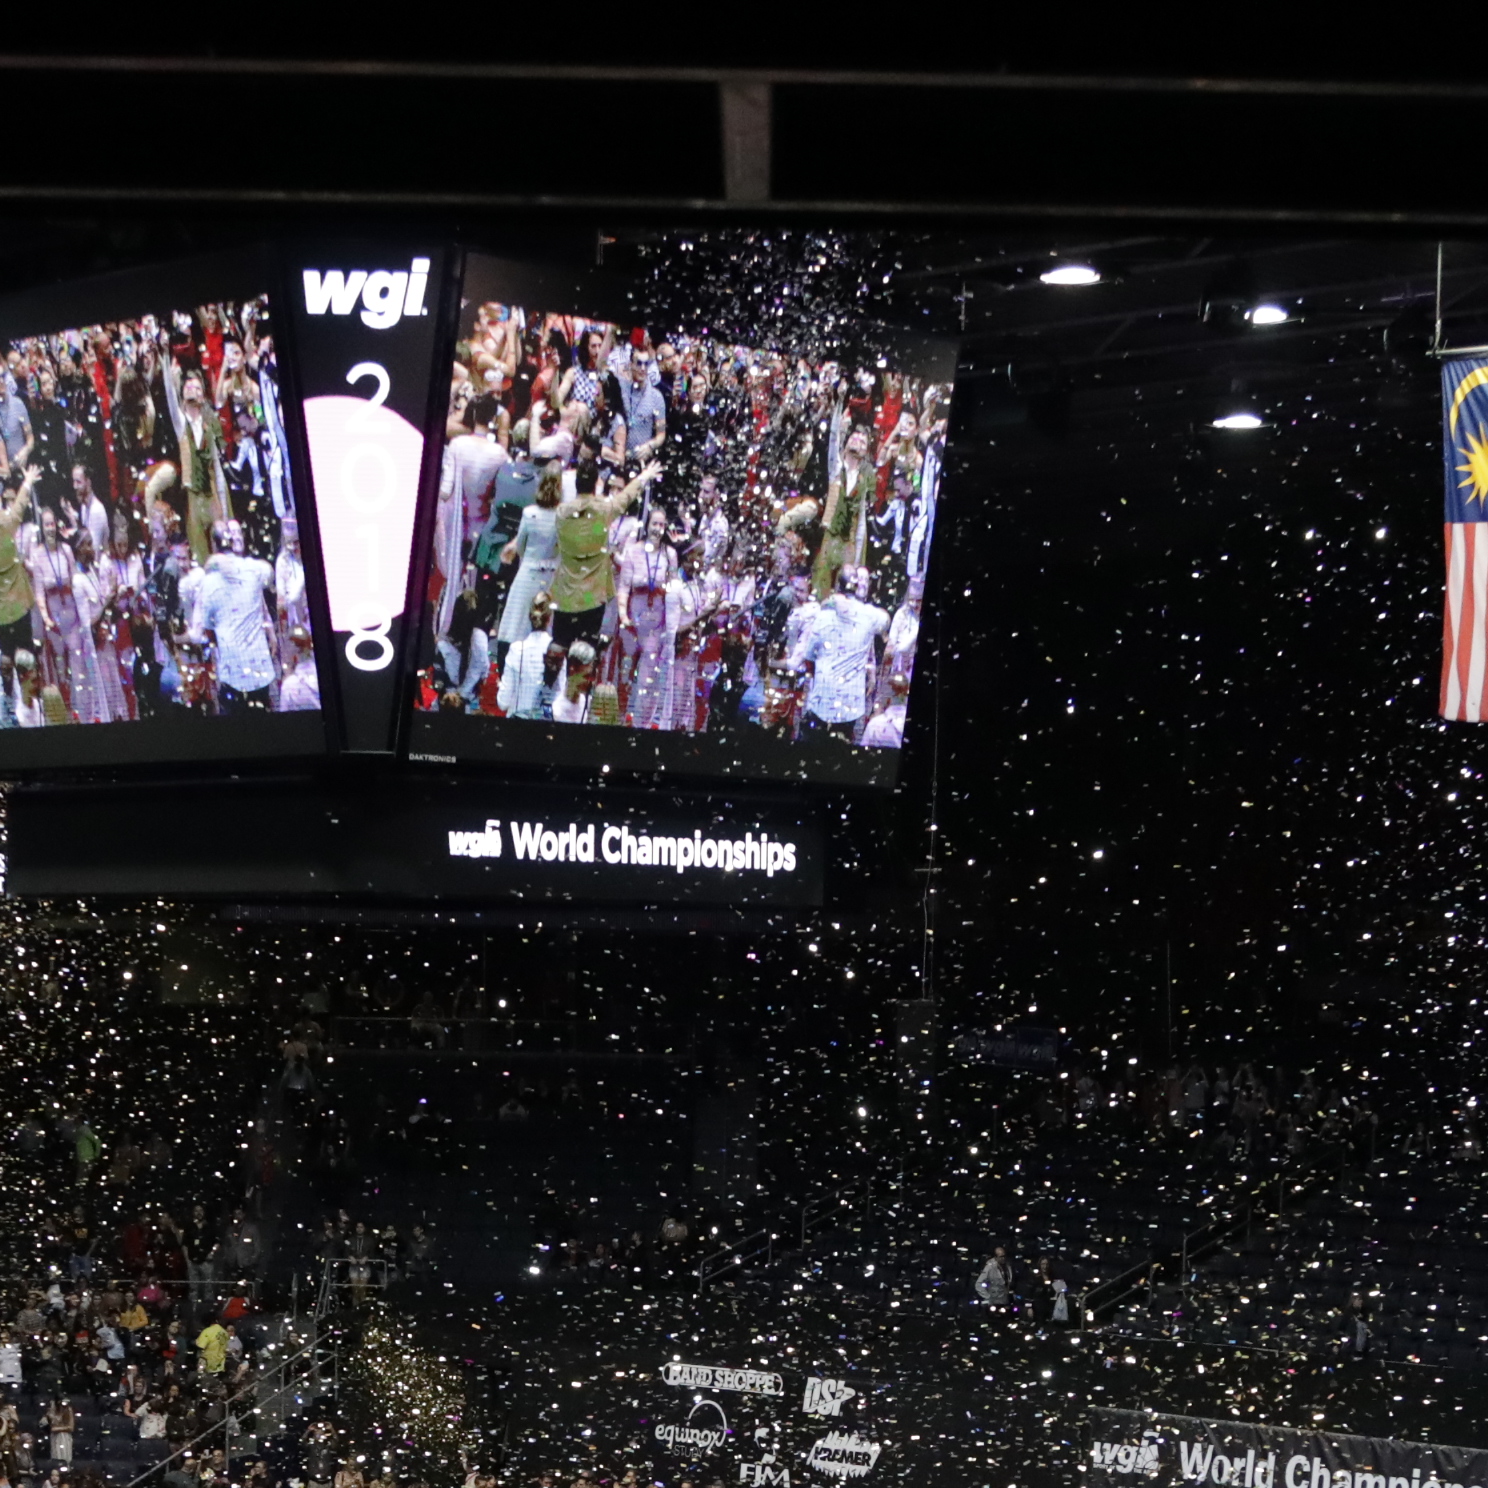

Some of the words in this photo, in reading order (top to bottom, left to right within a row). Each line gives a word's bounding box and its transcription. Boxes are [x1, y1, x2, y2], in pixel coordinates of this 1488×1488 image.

[409, 753, 456, 763] DAKTRONICS
[511, 821, 595, 862] World
[602, 825, 797, 877] Championships
[669, 1365, 713, 1386] BAND
[714, 1369, 776, 1393] SHOPPE
[655, 1422, 722, 1453] equinox
